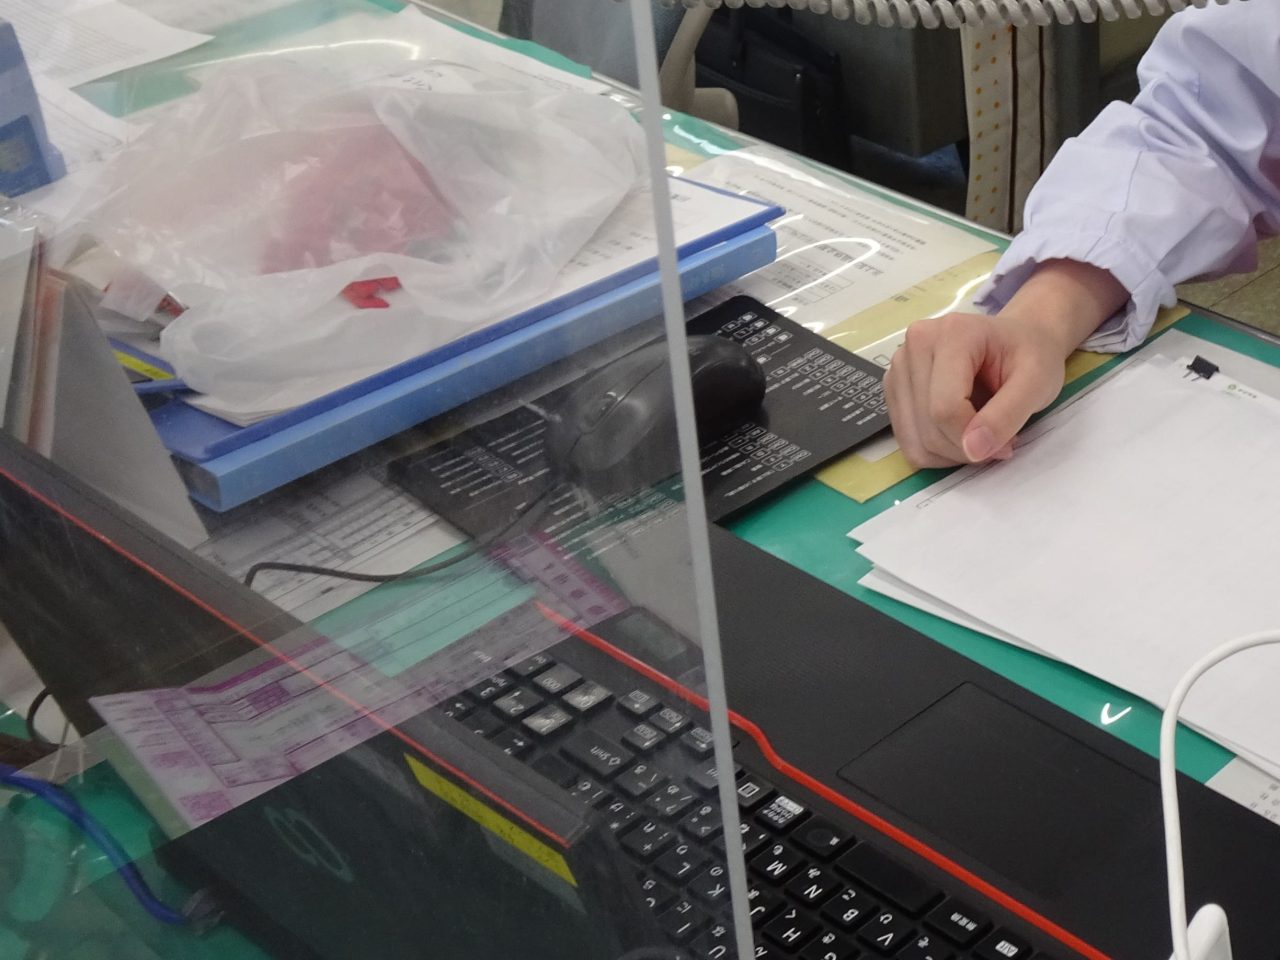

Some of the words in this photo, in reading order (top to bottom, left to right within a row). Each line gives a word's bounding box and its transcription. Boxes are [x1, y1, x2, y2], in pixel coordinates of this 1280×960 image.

[479, 682, 495, 700] 3
[509, 701, 524, 716] 2
[774, 845, 783, 855] も
[679, 863, 690, 874] L
[711, 867, 723, 875] の
[767, 861, 786, 875] M
[808, 869, 820, 878] み
[708, 884, 724, 896] K
[804, 885, 822, 898] N
[843, 890, 855, 900] こ
[786, 910, 795, 918] く
[843, 909, 858, 921] B
[880, 914, 892, 923] ひ
[783, 928, 800, 941] H
[877, 933, 893, 945] V
[709, 946, 725, 958] U
